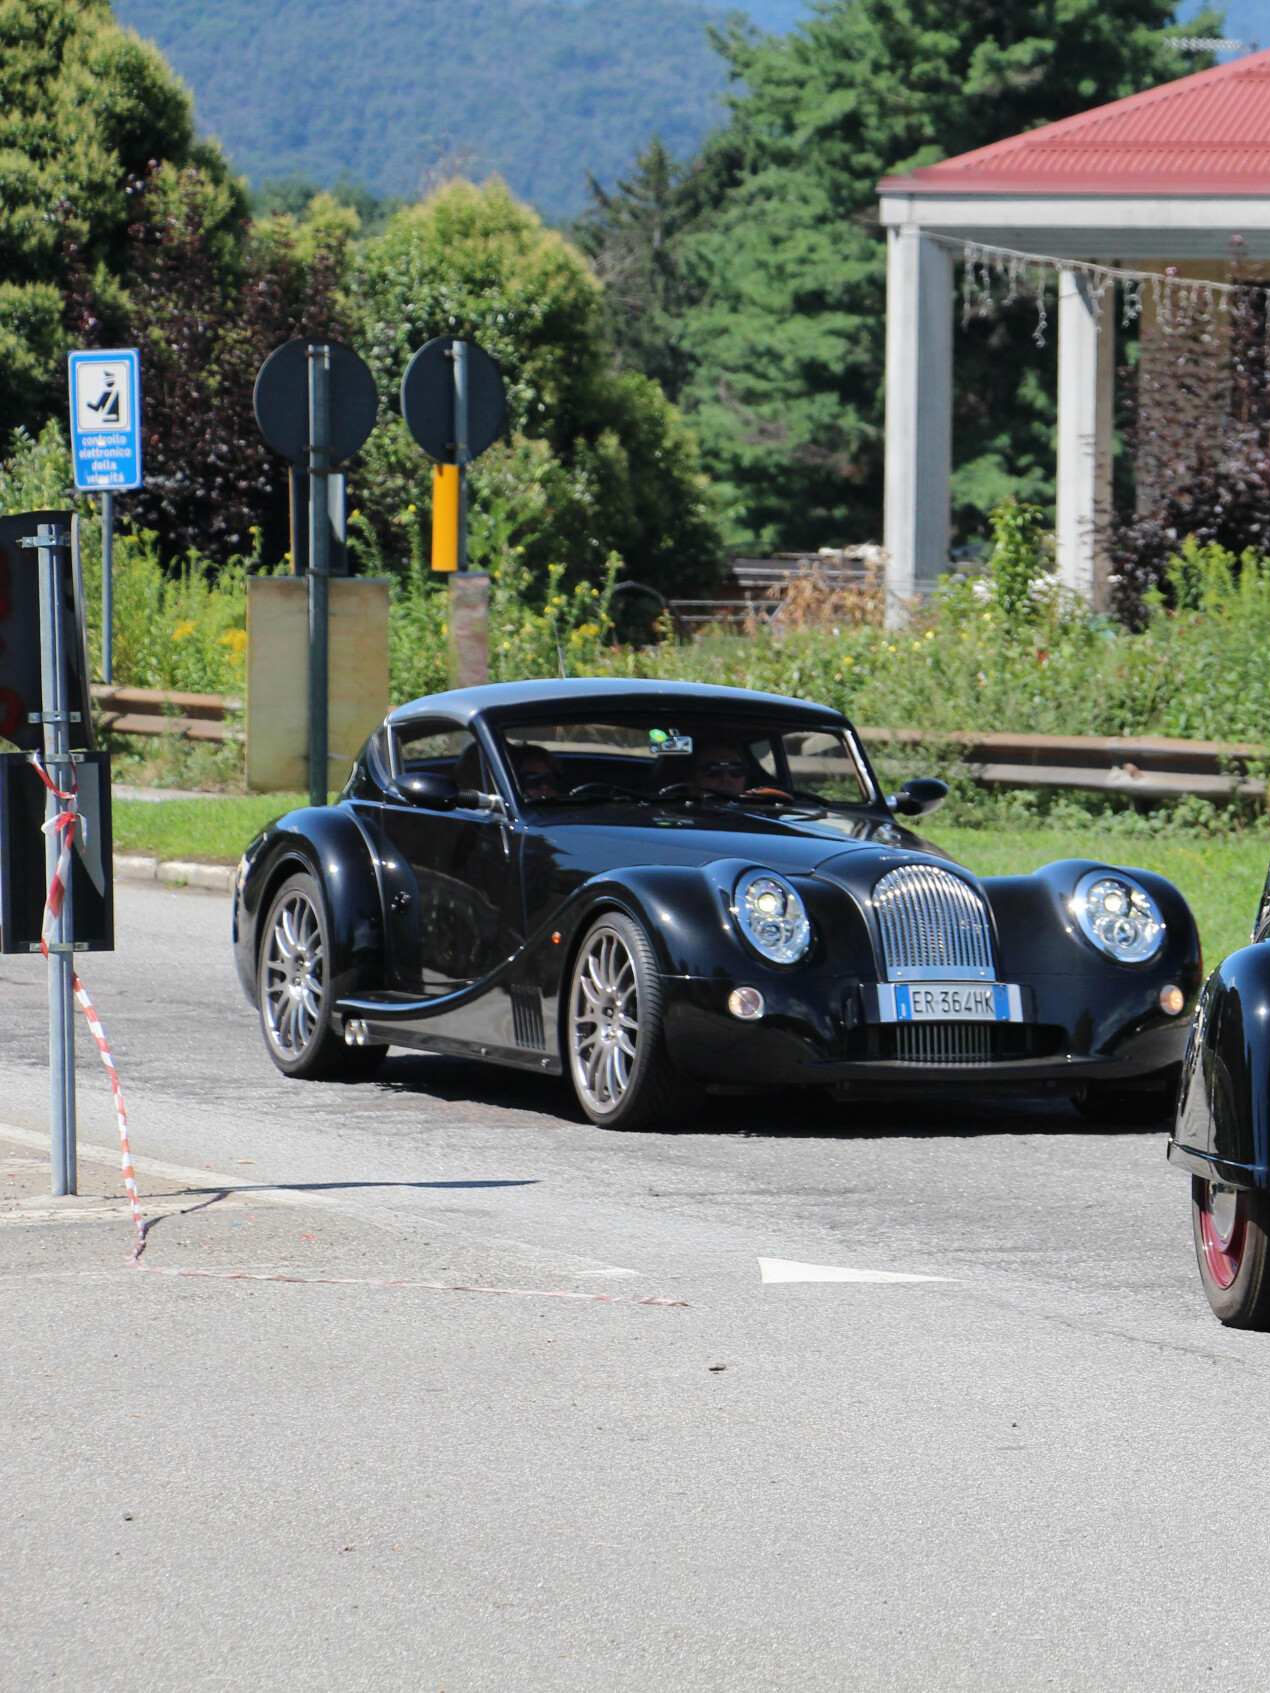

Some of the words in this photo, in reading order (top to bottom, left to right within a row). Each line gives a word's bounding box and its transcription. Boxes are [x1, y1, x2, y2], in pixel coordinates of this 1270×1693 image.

[81, 433, 127, 447] controllo
[79, 446, 132, 458] elettronico
[91, 459, 117, 471] della
[912, 991, 934, 1013] ER
[940, 991, 994, 1013] 364HK
